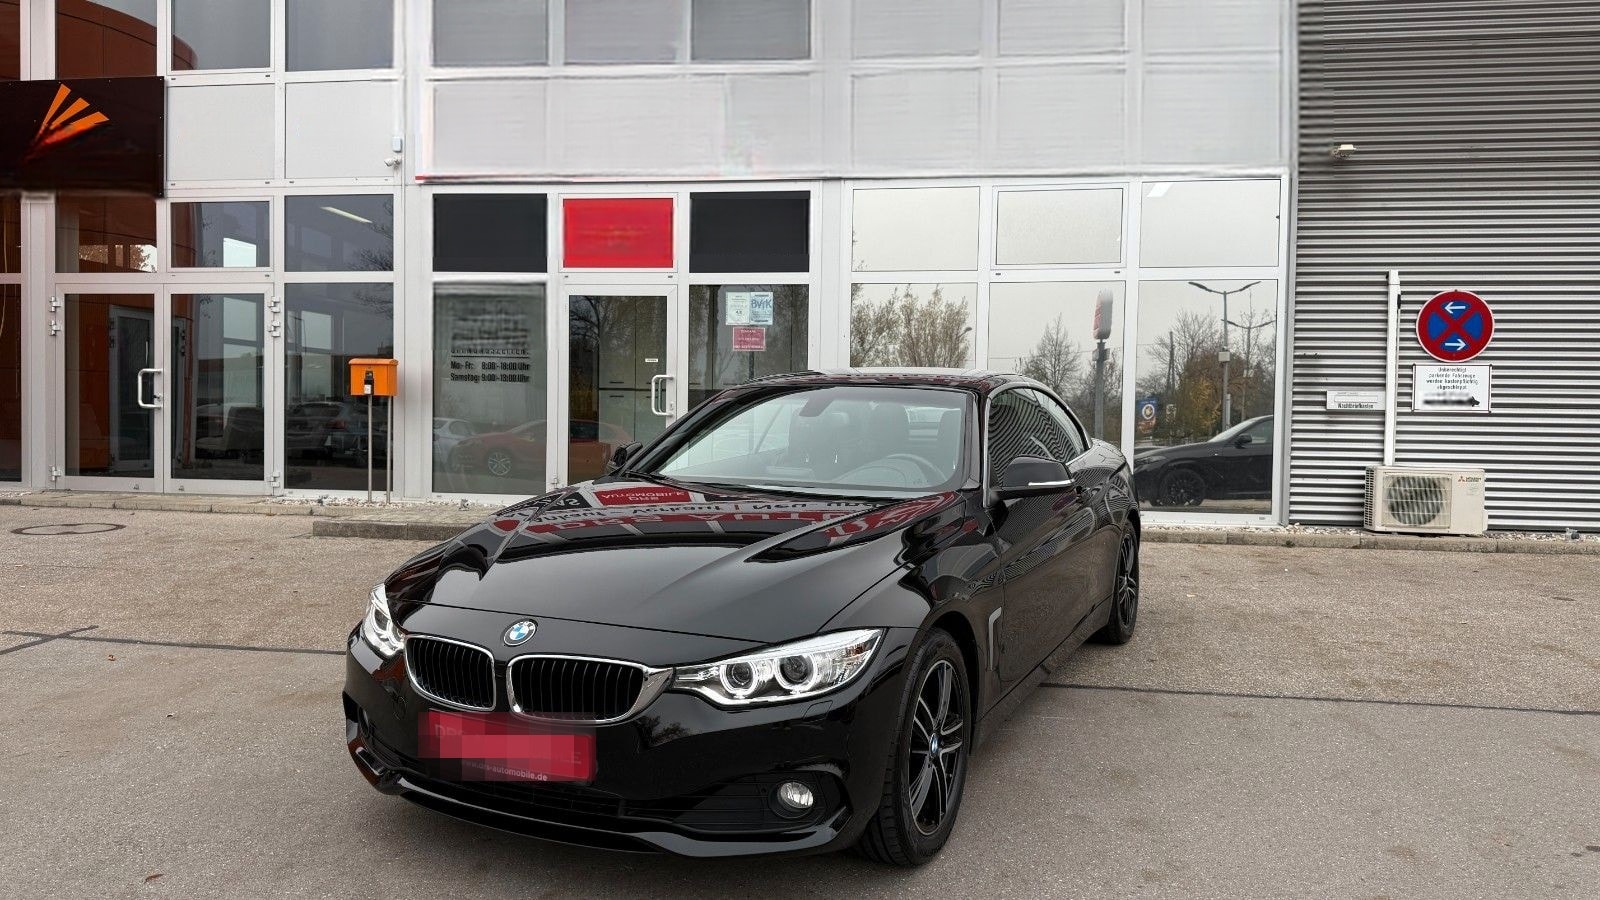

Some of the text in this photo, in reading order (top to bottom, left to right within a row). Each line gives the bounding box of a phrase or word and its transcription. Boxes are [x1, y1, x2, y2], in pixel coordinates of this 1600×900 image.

[500, 362, 517, 370] 18:00
[517, 363, 530, 371] Uhr
[450, 373, 479, 383] Samstag:
[517, 374, 530, 383] Uhr
